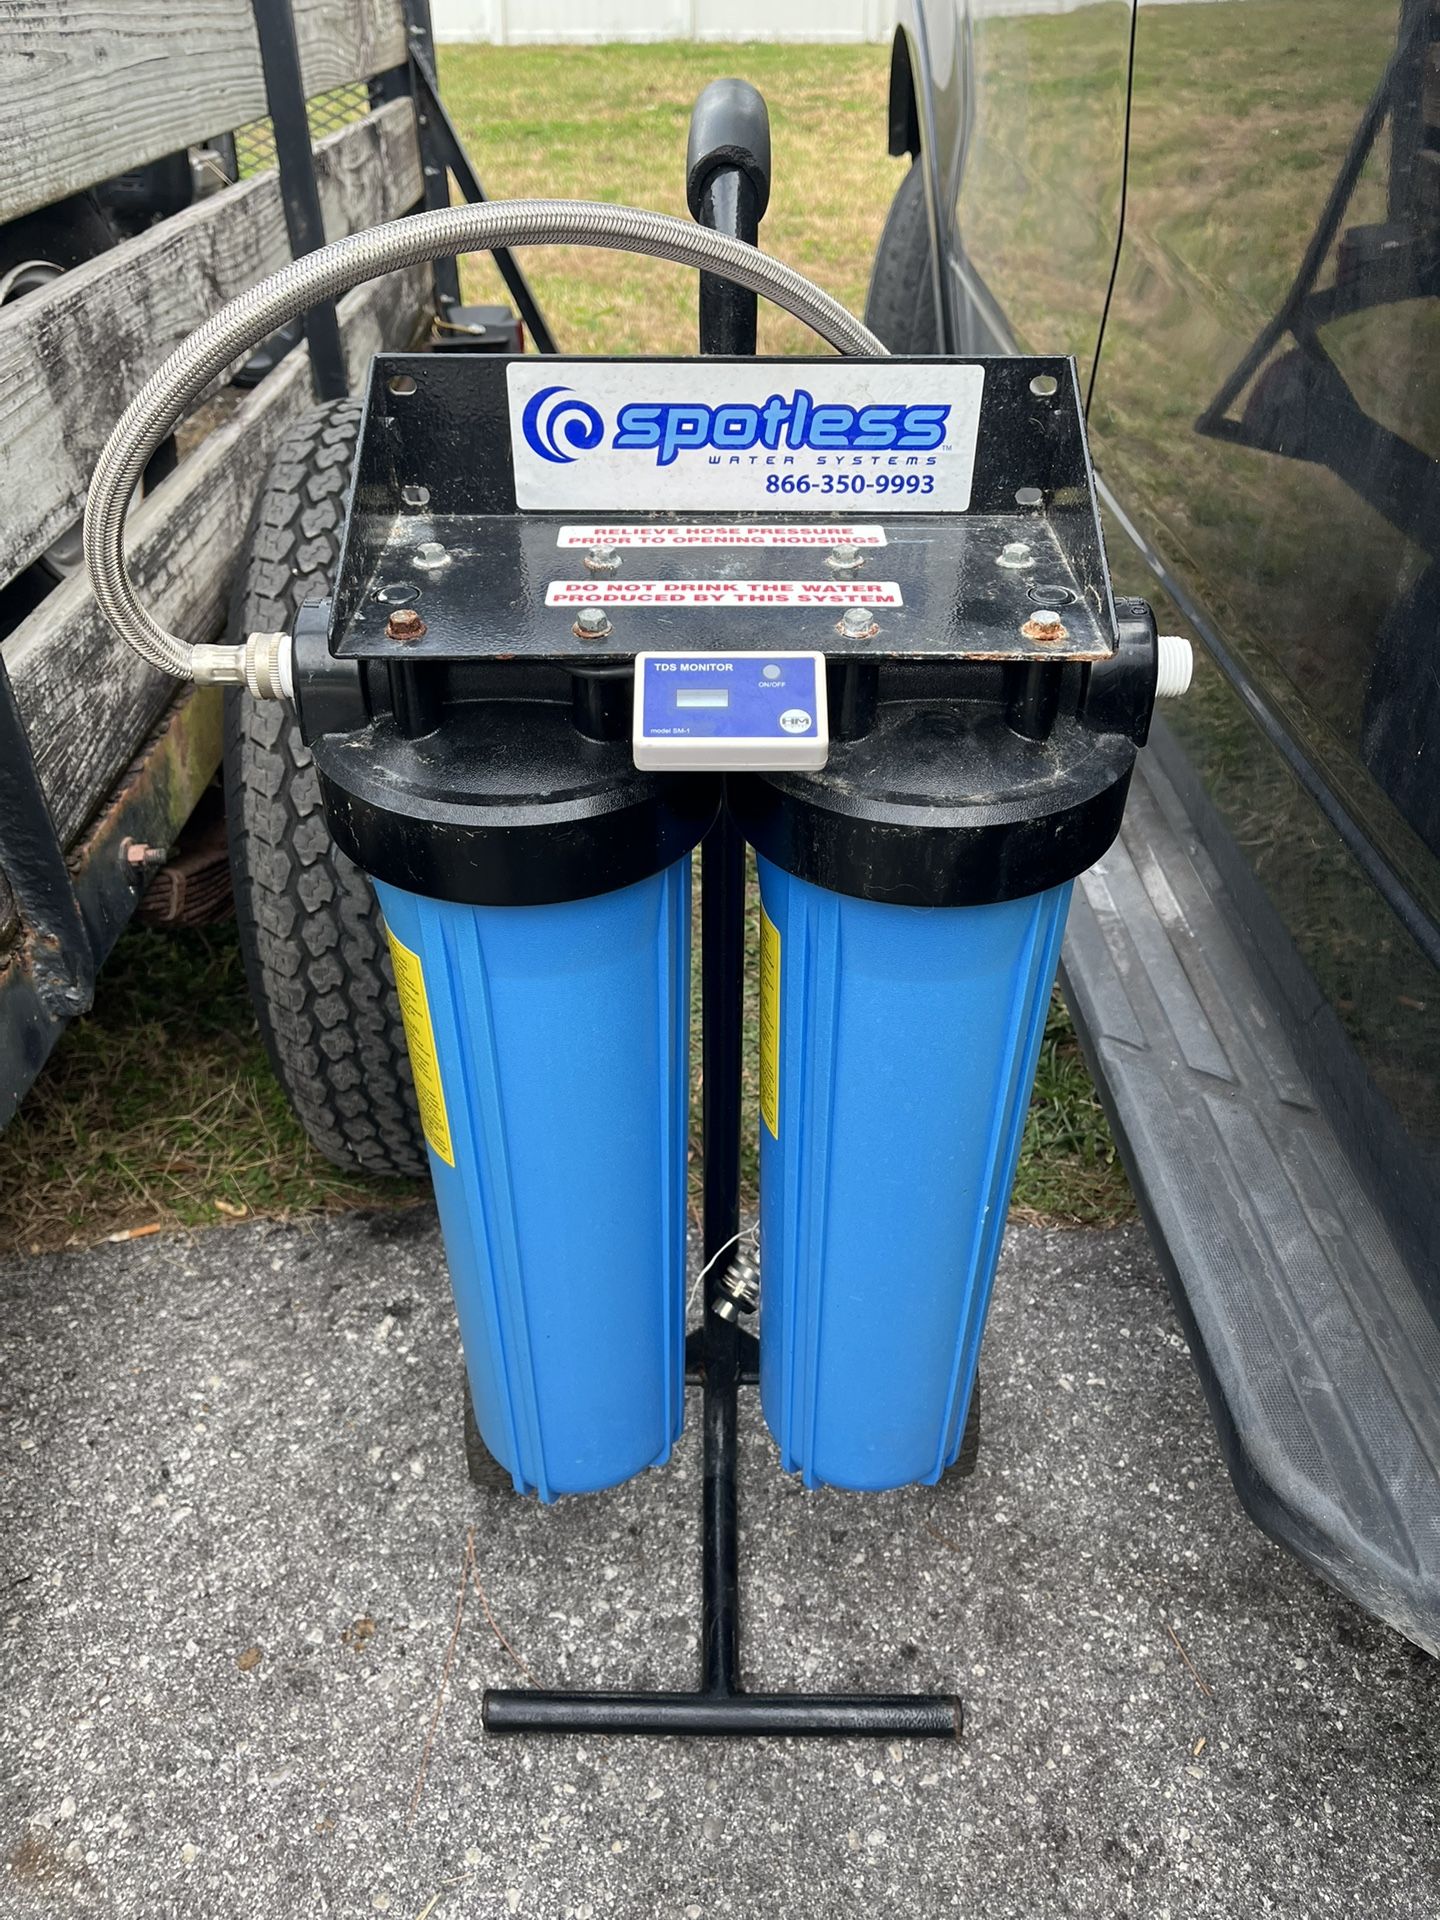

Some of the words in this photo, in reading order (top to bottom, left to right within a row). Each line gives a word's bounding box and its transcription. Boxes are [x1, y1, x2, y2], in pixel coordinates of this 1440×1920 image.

[612, 389, 952, 466] spotless
[709, 456, 795, 465] WATER
[816, 456, 937, 465] SYSTEMS
[766, 474, 935, 494] 866-350-9993
[565, 584, 599, 592] DO
[607, 584, 656, 592] NOT
[664, 584, 739, 592] DRINK
[747, 584, 794, 592] THE
[802, 585, 882, 593] WATER
[553, 594, 685, 602] PRODUCED
[693, 594, 725, 602] BY
[733, 594, 789, 602] THIS
[797, 594, 895, 603] SYSTEM
[654, 663, 677, 672] TDS
[679, 663, 734, 672] MONITOR
